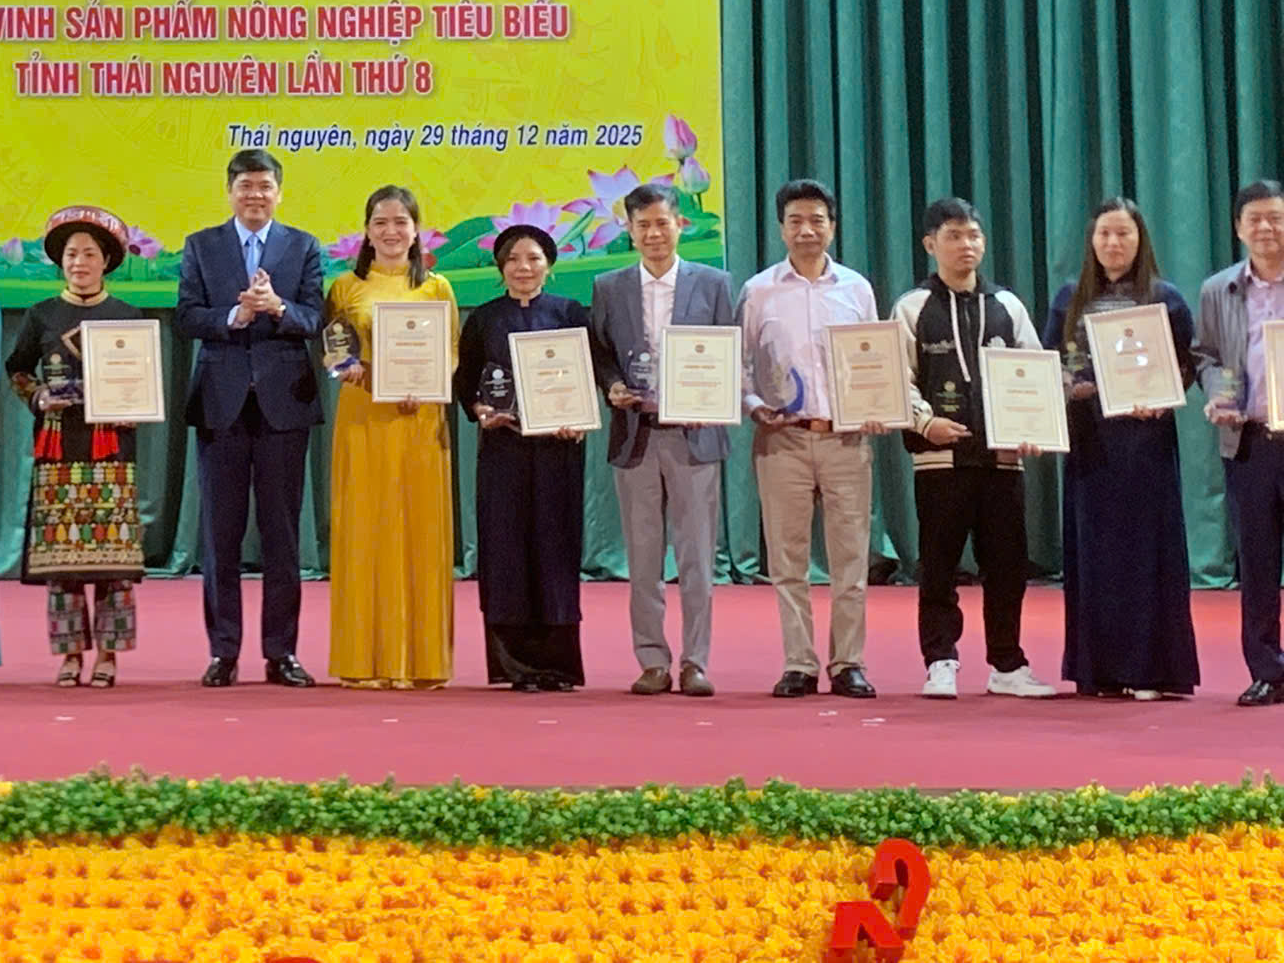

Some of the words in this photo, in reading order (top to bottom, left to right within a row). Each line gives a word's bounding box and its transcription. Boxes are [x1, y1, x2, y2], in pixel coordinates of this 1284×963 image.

[227, 0, 307, 39] NÔNG
[317, 0, 422, 45] NGHIỆP
[15, 51, 80, 95] TỈNH
[89, 55, 152, 95] THÁI
[162, 55, 277, 94] NGUYÊN
[287, 50, 342, 94] LẦN
[351, 53, 409, 94] THỨ
[415, 61, 432, 93] 8
[228, 124, 271, 147] Thái
[277, 124, 357, 152] nguyên,
[365, 123, 414, 152] ngày
[420, 124, 444, 146] 29
[451, 123, 509, 152] tháng
[517, 124, 539, 146] 12
[545, 124, 588, 146] năm
[595, 124, 643, 146] 2025
